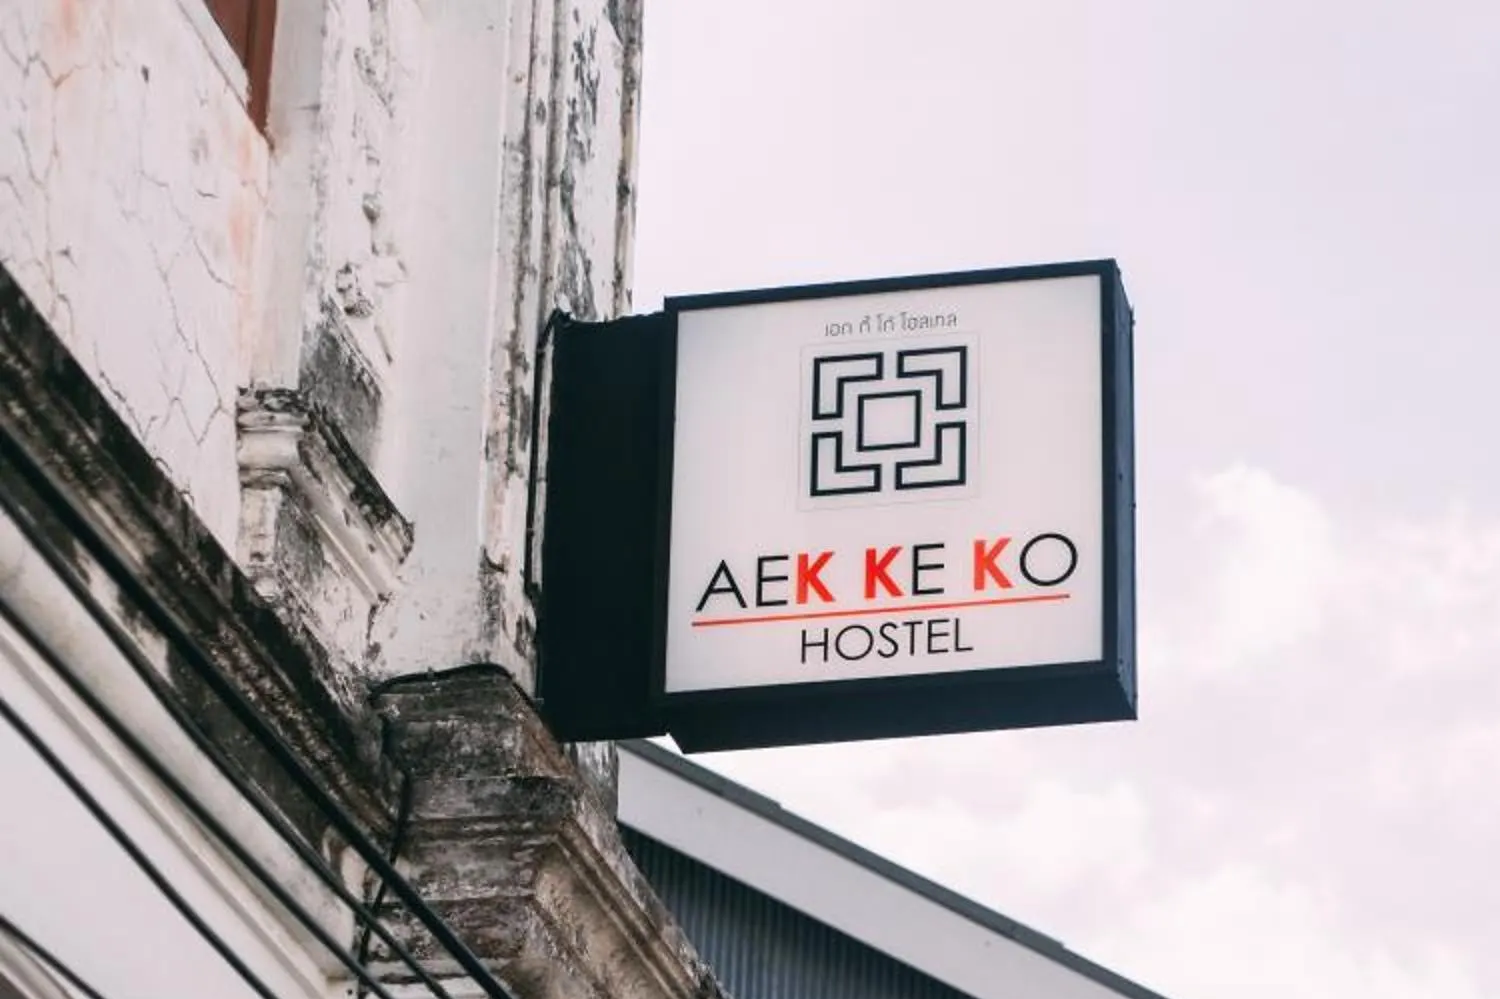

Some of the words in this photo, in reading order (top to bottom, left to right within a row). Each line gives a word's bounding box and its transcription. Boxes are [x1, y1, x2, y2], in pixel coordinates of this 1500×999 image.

[695, 551, 836, 614] AEK
[863, 542, 946, 601] KE
[972, 532, 1080, 592] KO
[800, 617, 975, 665] HOSTEL
